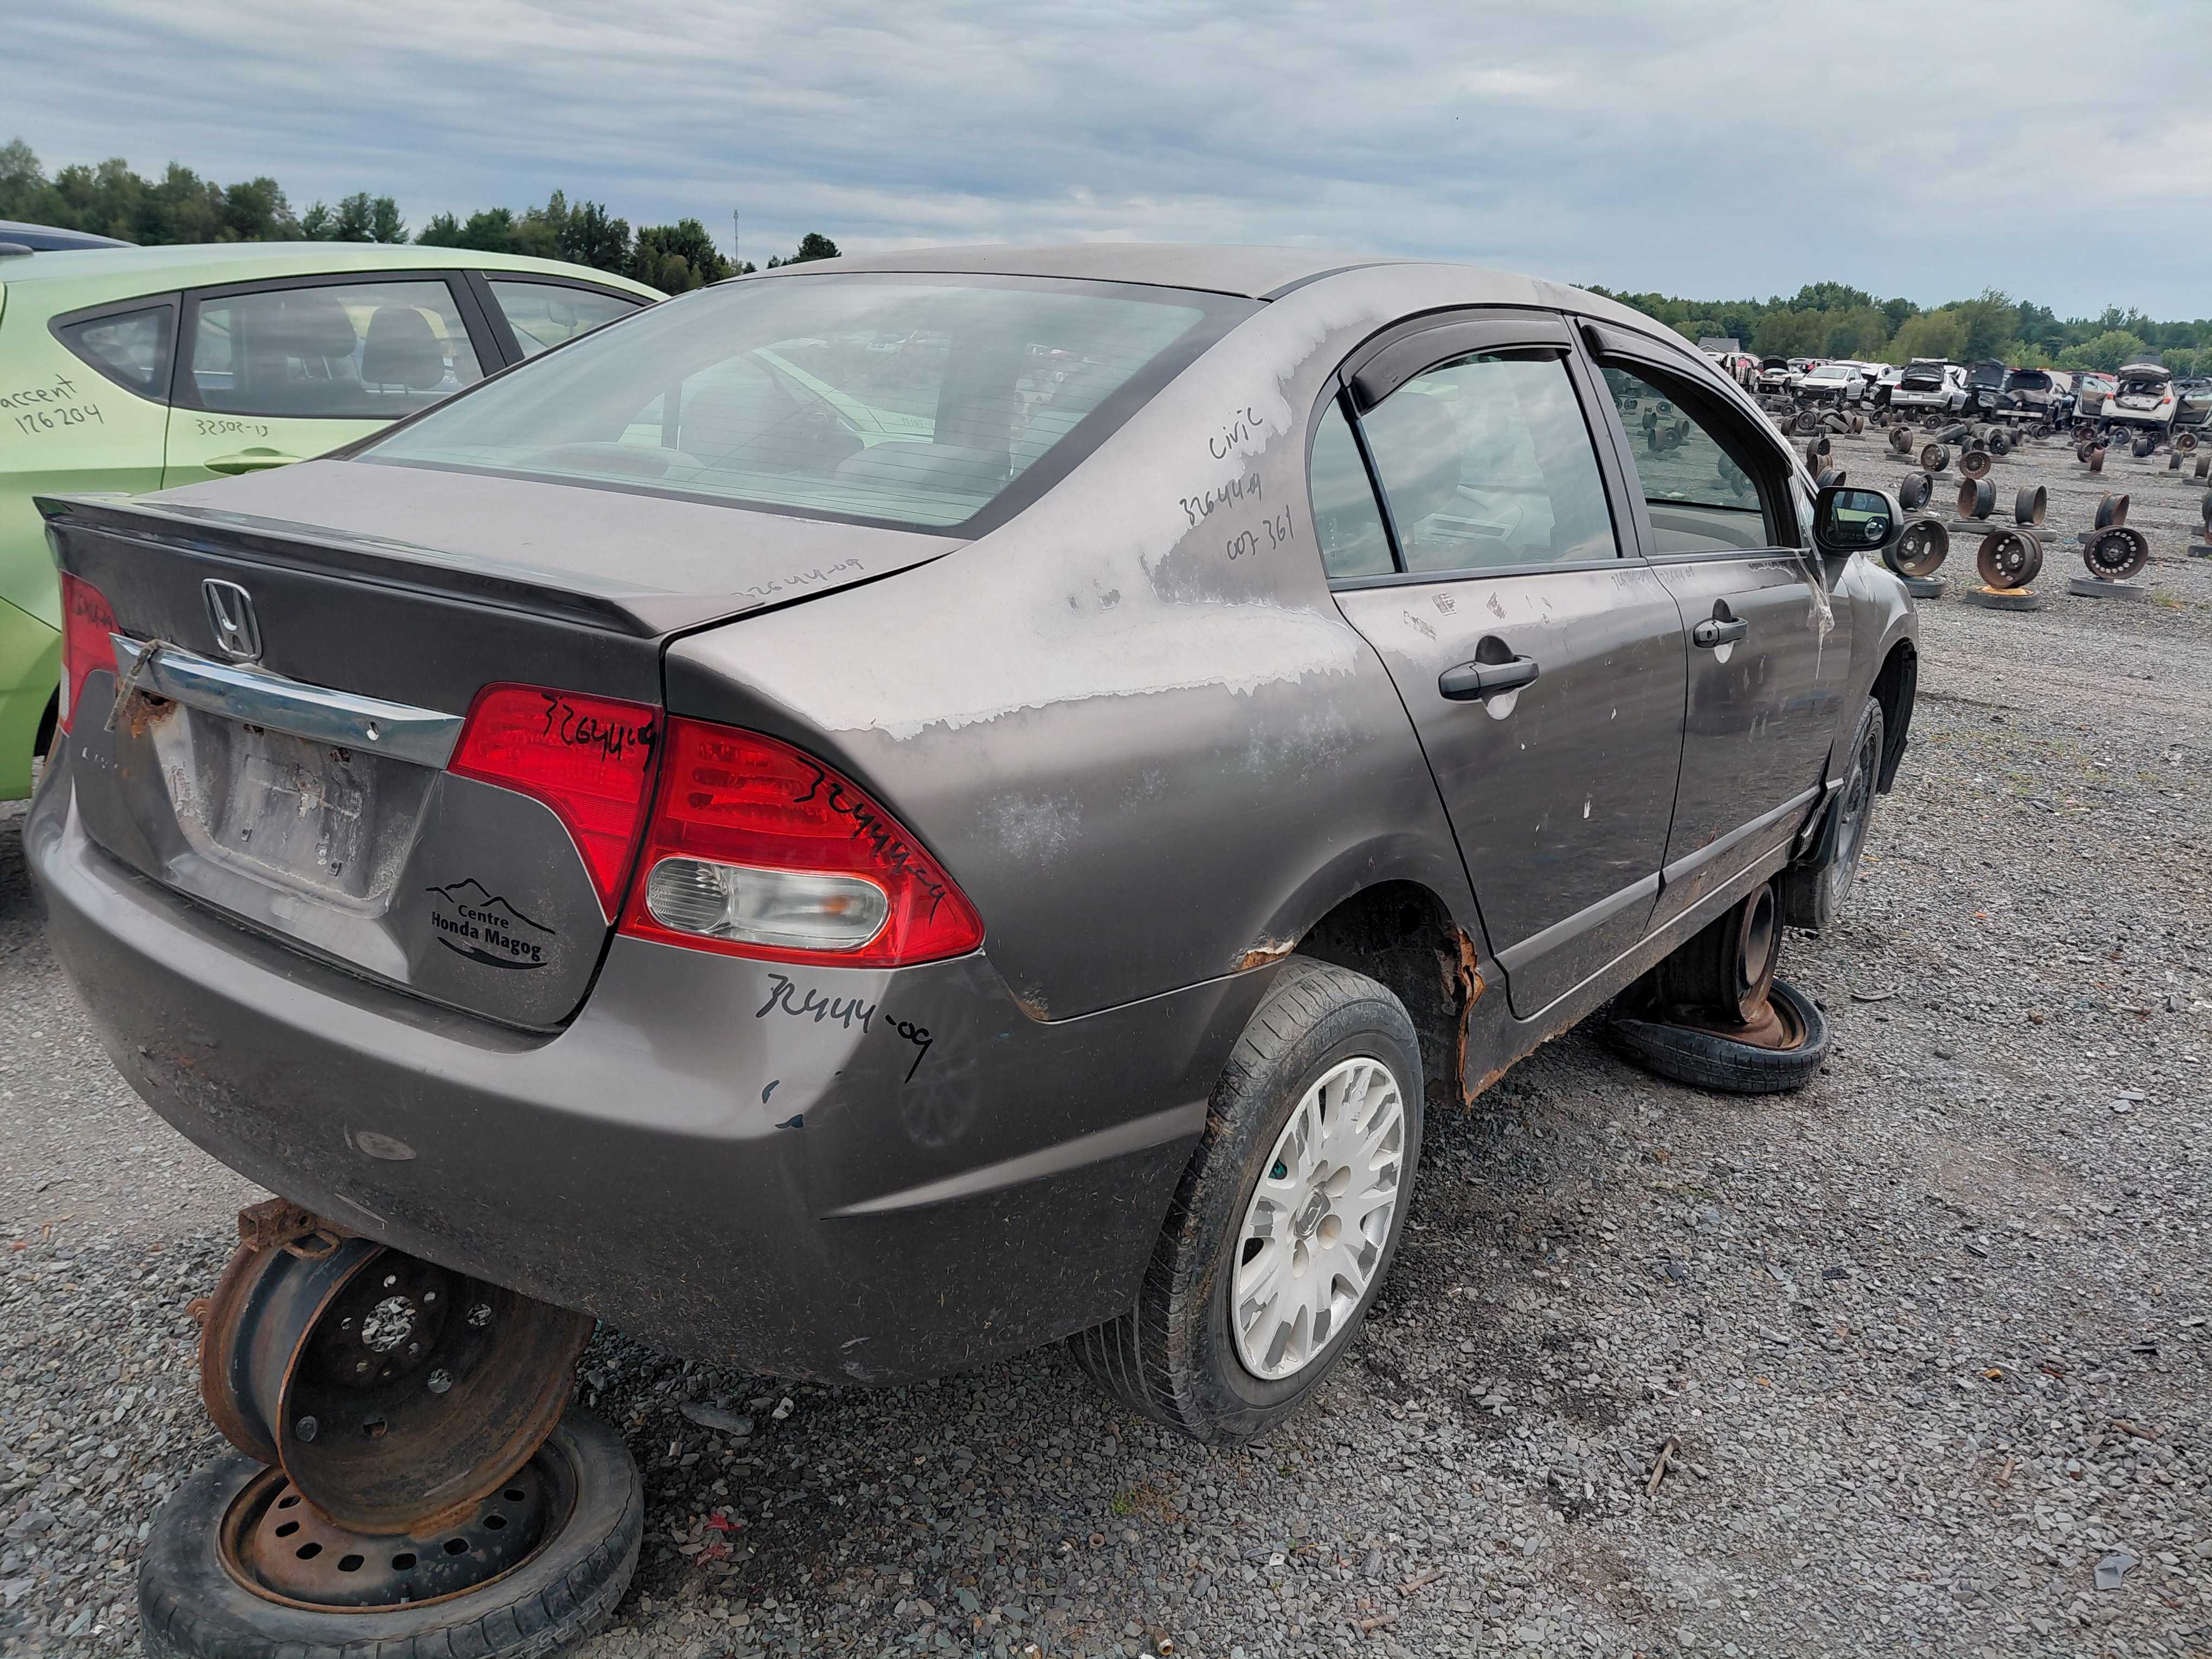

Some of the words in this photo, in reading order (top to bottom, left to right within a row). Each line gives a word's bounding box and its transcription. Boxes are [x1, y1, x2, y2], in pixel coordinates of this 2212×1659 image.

[1, 373, 77, 408] accent
[458, 904, 510, 929] Centre
[431, 911, 479, 940] Honda
[485, 928, 542, 962] Magog
